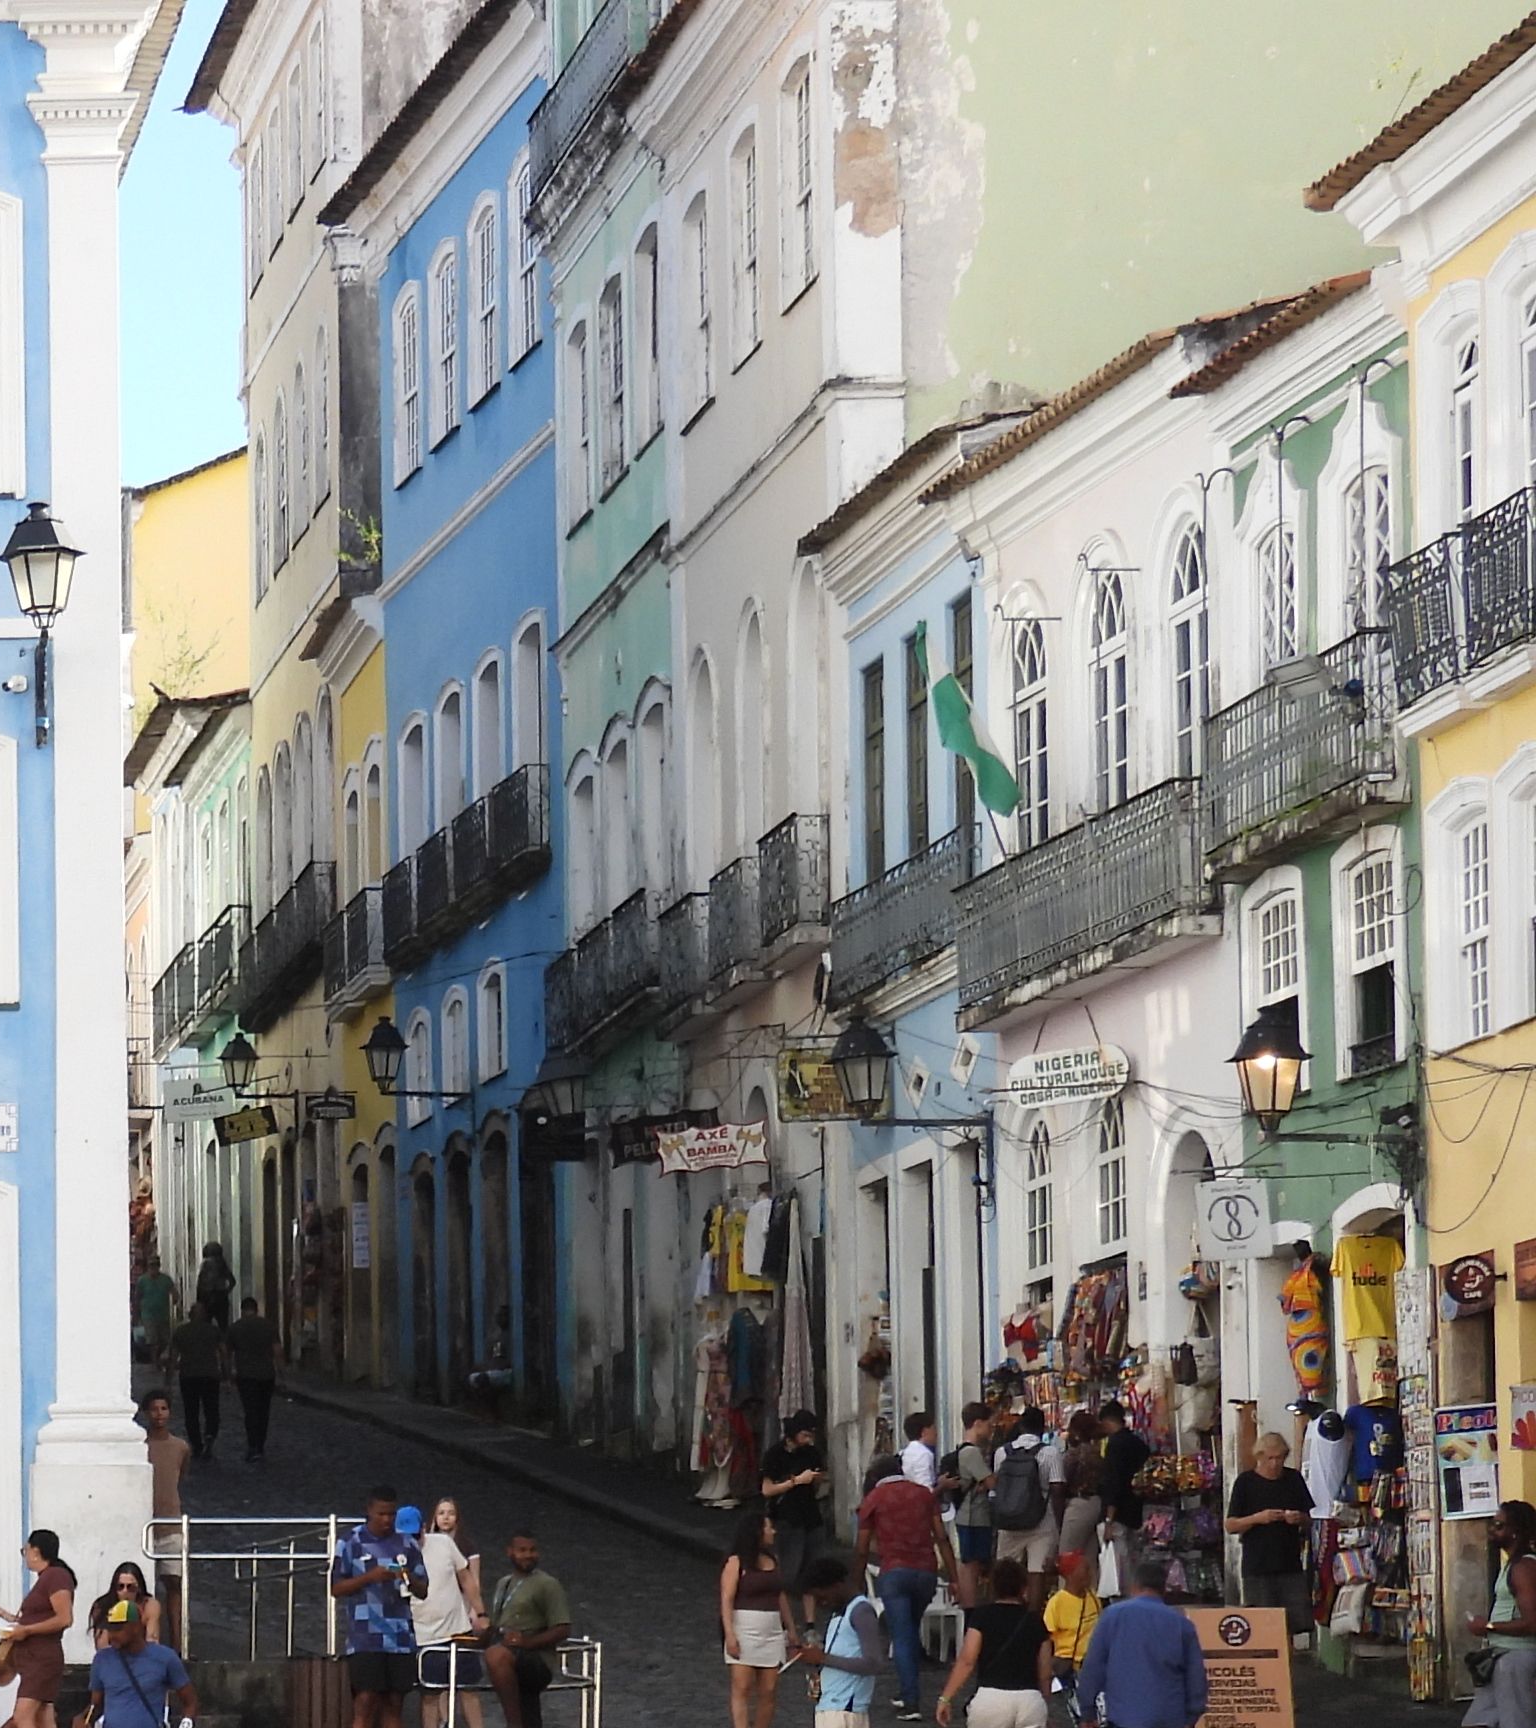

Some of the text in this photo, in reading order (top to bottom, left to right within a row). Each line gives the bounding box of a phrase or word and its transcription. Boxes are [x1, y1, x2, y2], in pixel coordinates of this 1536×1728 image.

[1034, 1051, 1100, 1074] NIGERIA
[1011, 1072, 1080, 1092] CULTURAL
[1020, 1089, 1053, 1105] CASA
[686, 1144, 736, 1158] BAMBA
[1208, 1679, 1258, 1688] ERVEJAS
